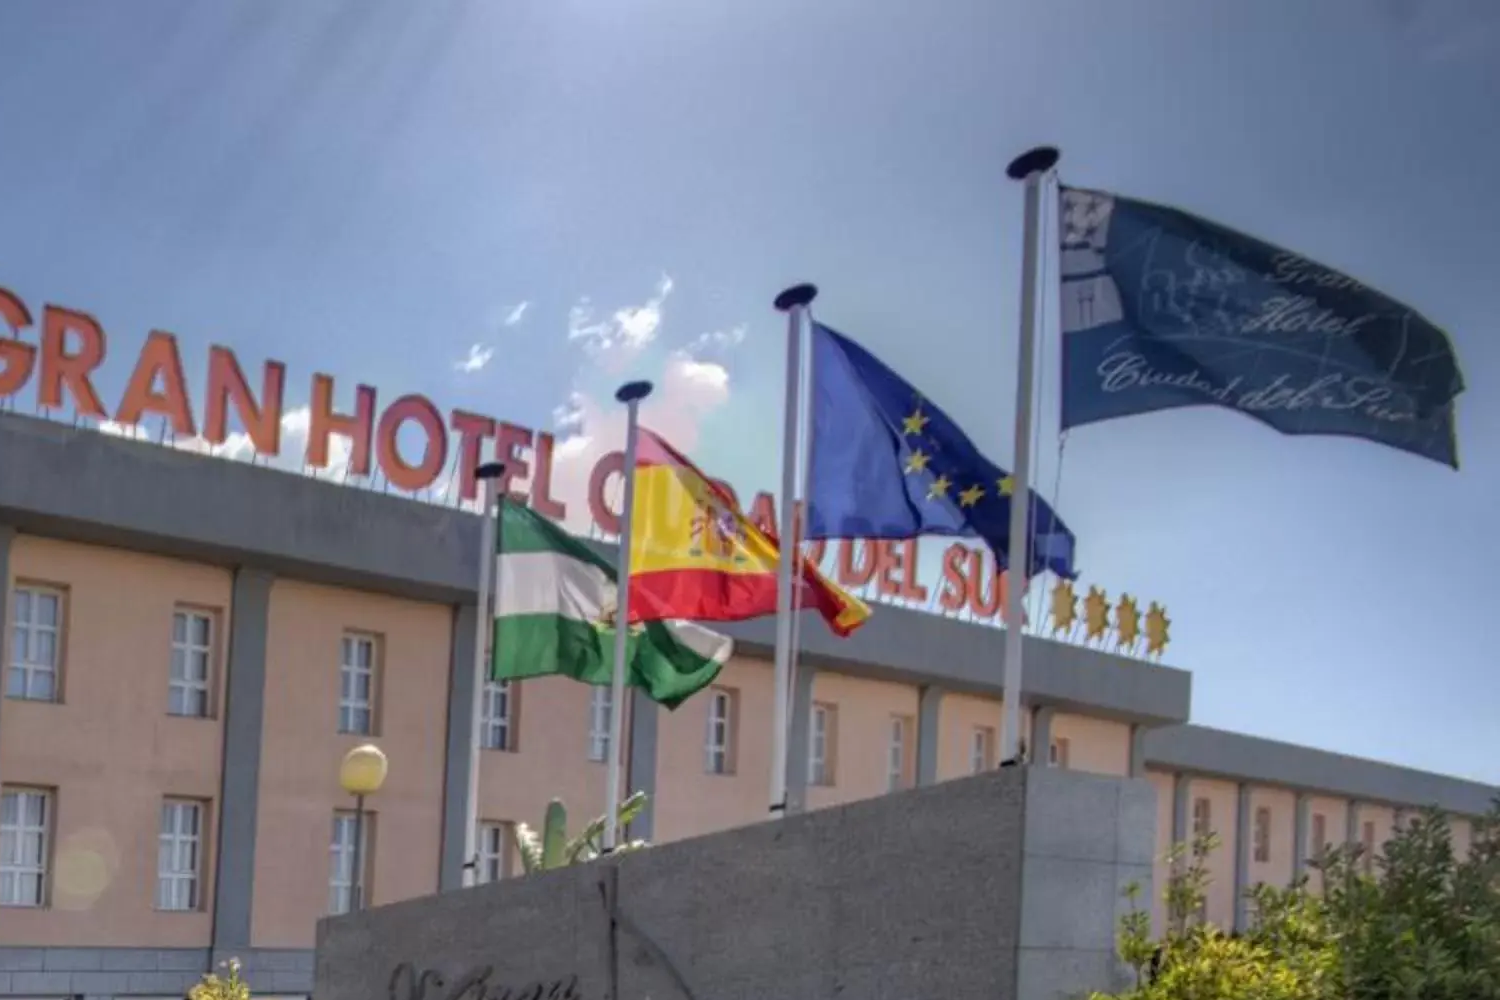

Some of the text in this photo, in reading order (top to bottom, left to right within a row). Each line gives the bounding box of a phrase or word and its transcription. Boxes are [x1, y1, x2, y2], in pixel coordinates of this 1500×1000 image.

[1096, 348, 1243, 403] Ciudad
[306, 371, 566, 521] HOTEL
[838, 528, 928, 602] DEL
